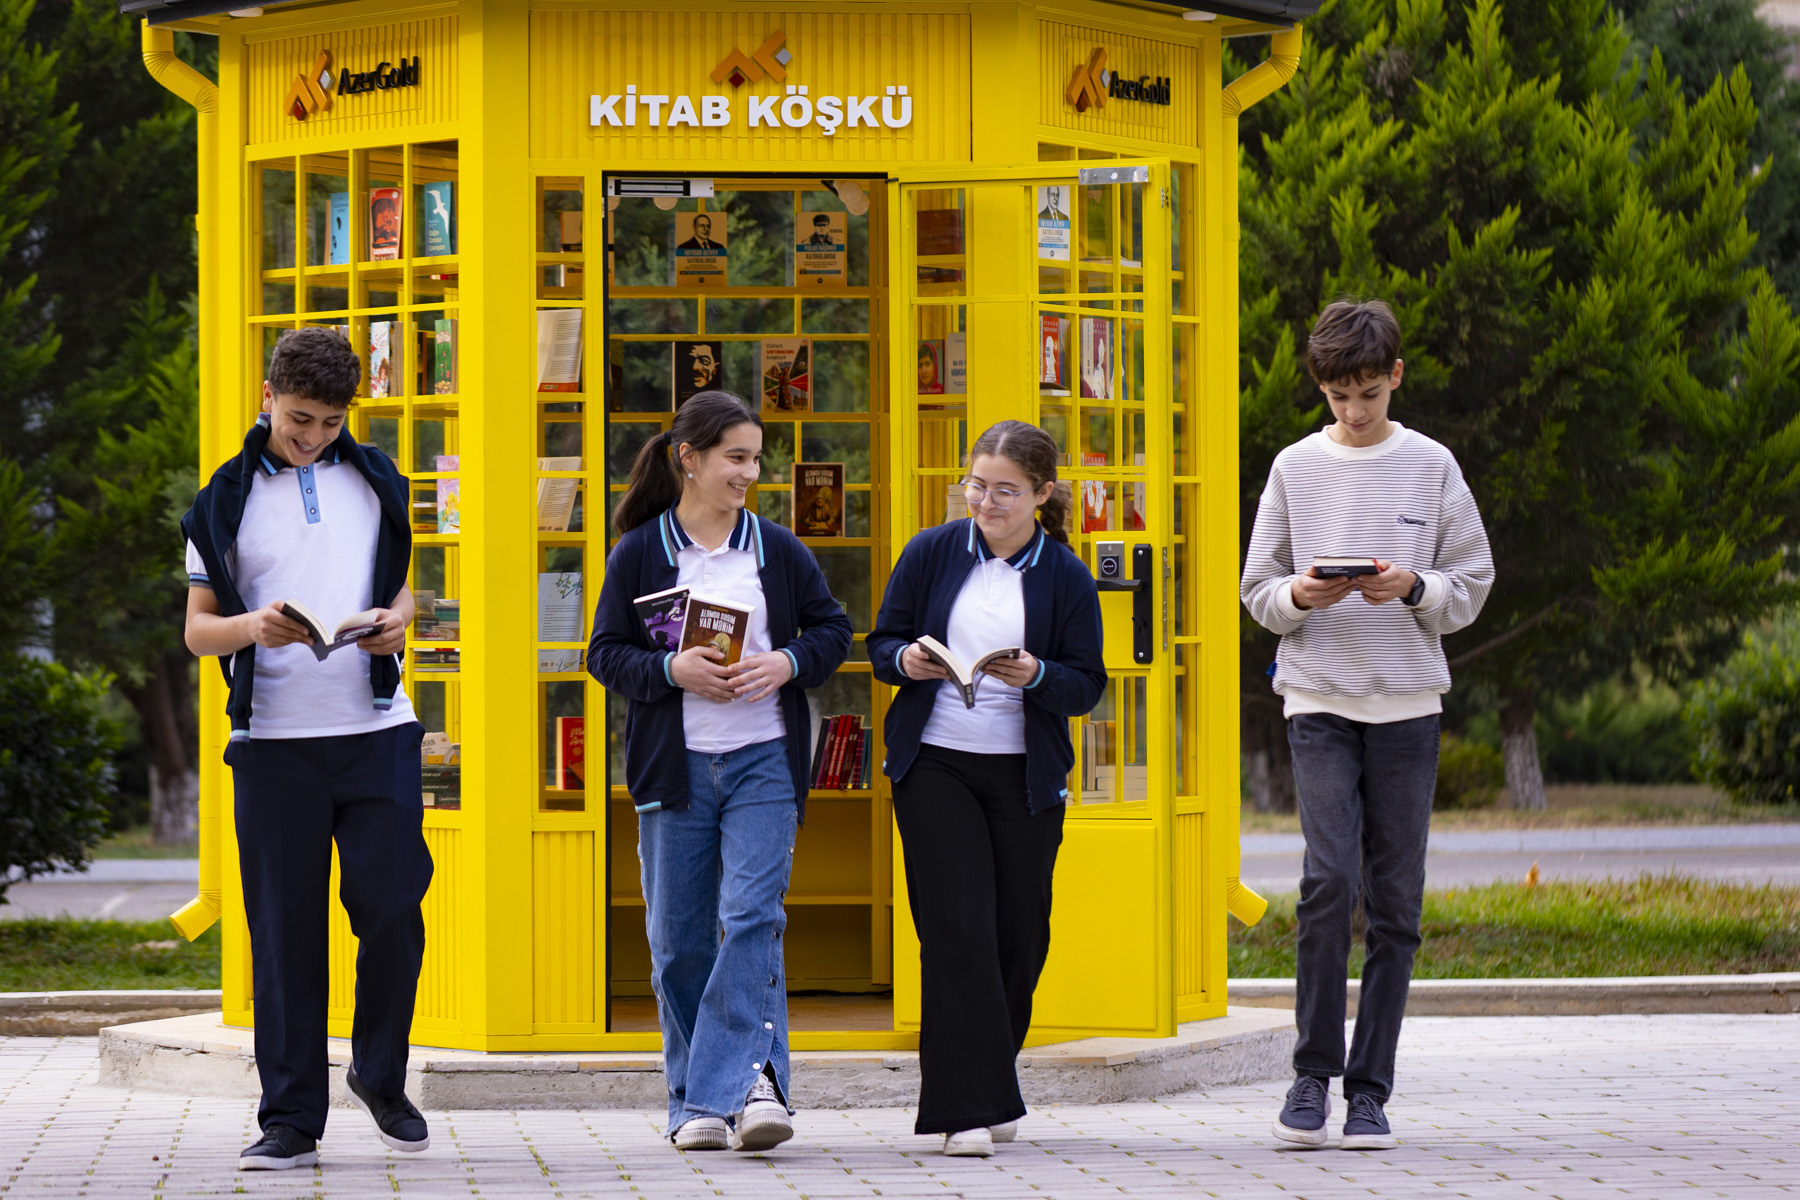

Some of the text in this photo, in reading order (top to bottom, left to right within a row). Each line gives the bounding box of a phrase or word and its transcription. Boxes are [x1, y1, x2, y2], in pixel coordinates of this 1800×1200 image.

[338, 56, 420, 96] AzerGold
[1109, 70, 1171, 106] AzerGold
[590, 84, 913, 136] KİTAB KÖŞKÜ
[699, 617, 735, 635] VAR MƏNİM
